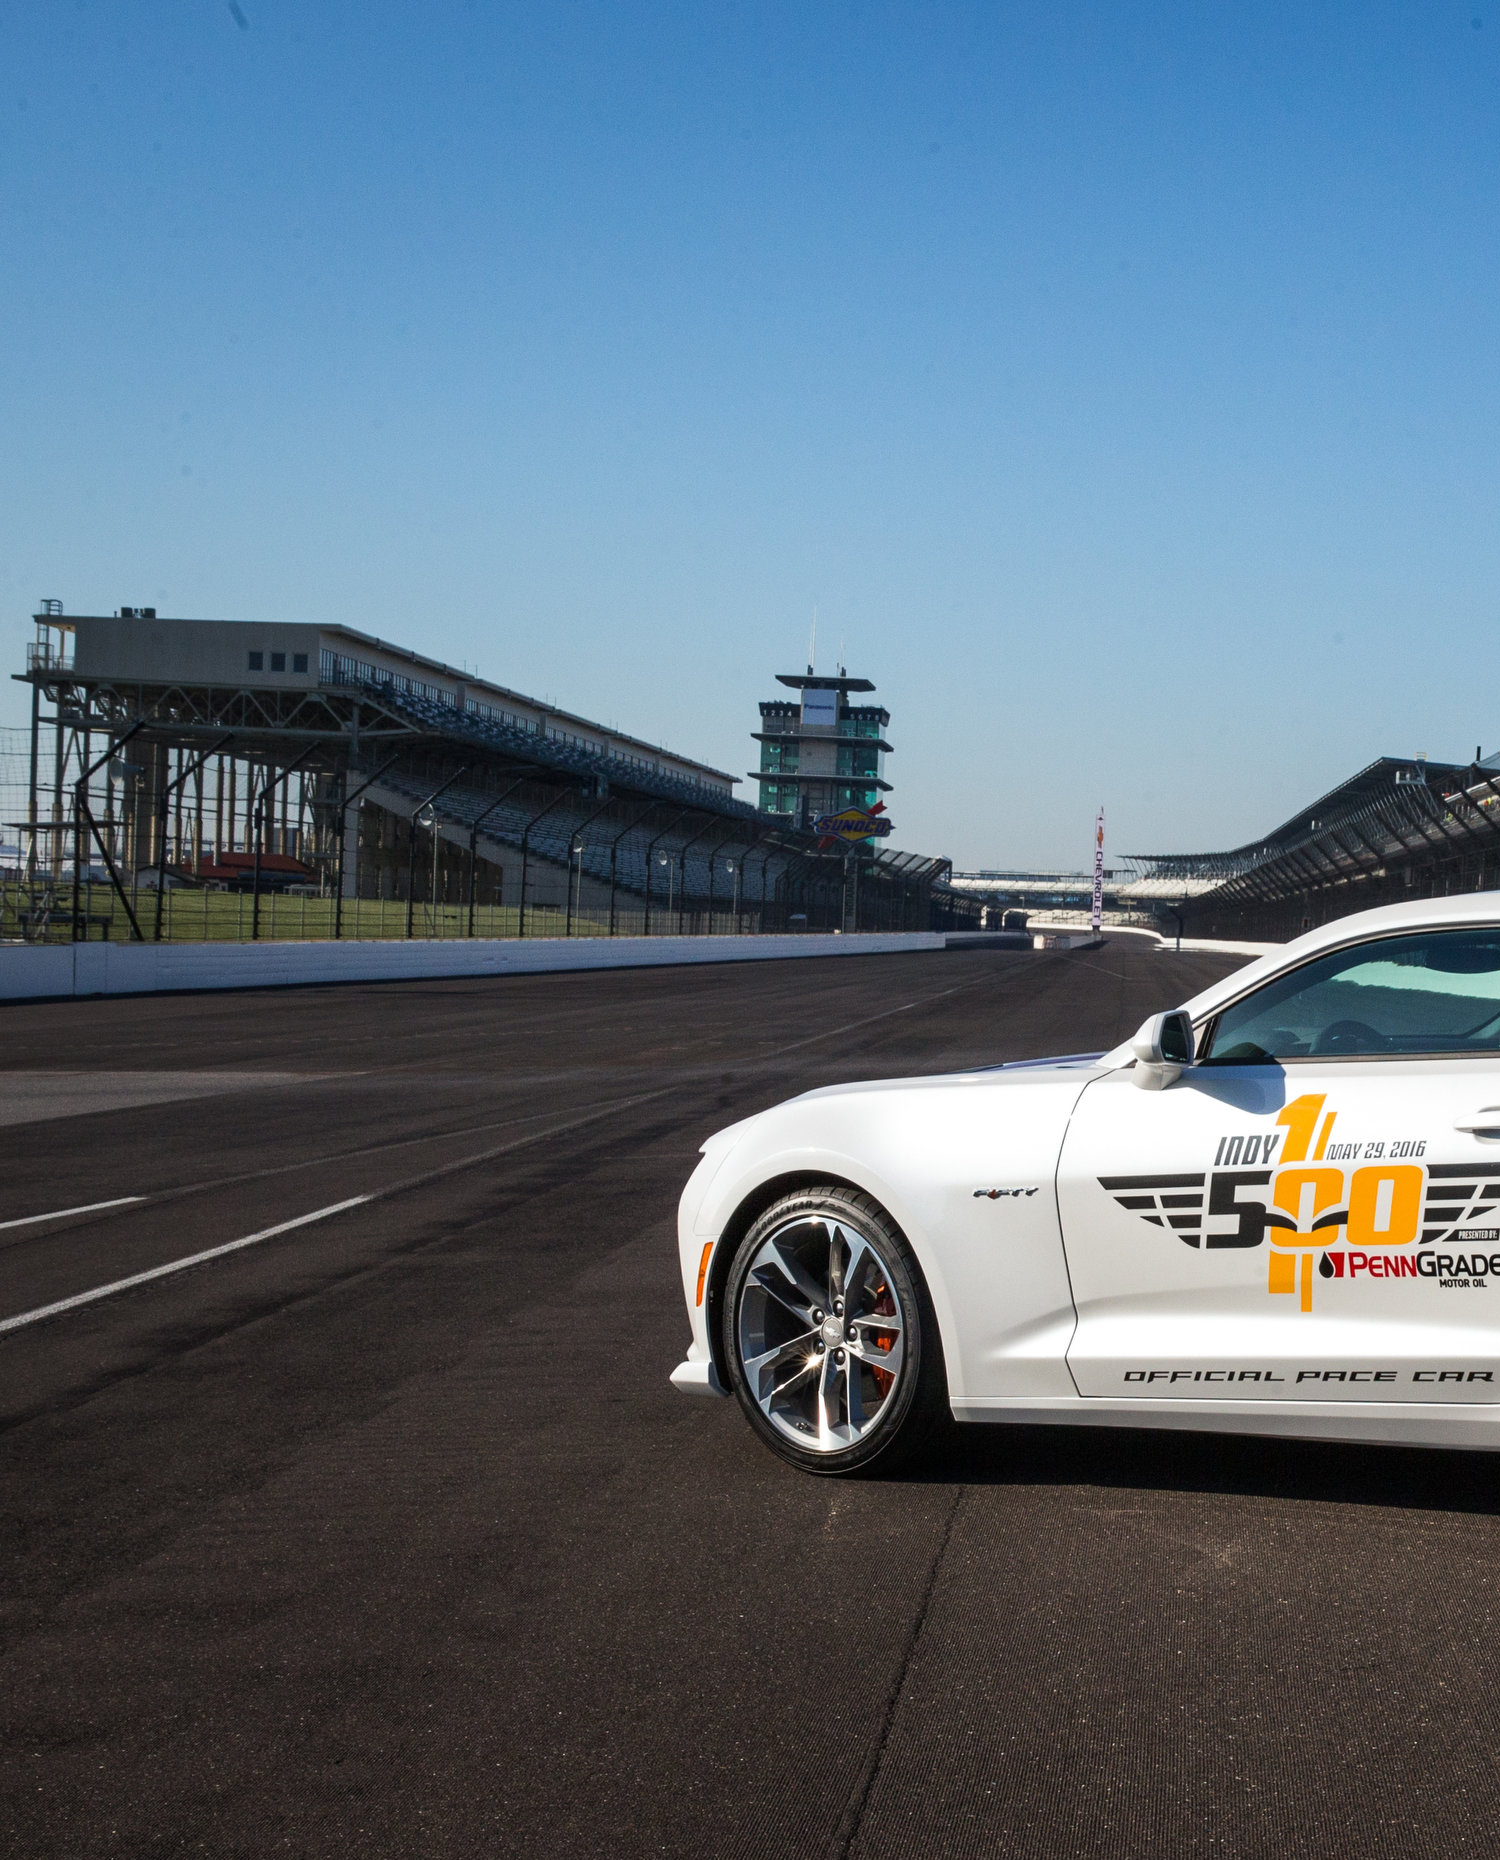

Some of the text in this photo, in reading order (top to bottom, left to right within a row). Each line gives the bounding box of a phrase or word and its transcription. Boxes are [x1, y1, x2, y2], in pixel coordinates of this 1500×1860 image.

[821, 818, 888, 833] SUNOCO
[1093, 851, 1103, 920] CHEVROLET
[1214, 1134, 1280, 1166] INDY
[1326, 1143, 1362, 1160] MAY
[1389, 1140, 1427, 1158] 2016
[1206, 1165, 1424, 1249] 500
[1458, 1230, 1488, 1240] PRESENTED
[1439, 1279, 1488, 1288] MOTOR OIL
[1124, 1371, 1495, 1384] OFFICIAL PACE CAR
